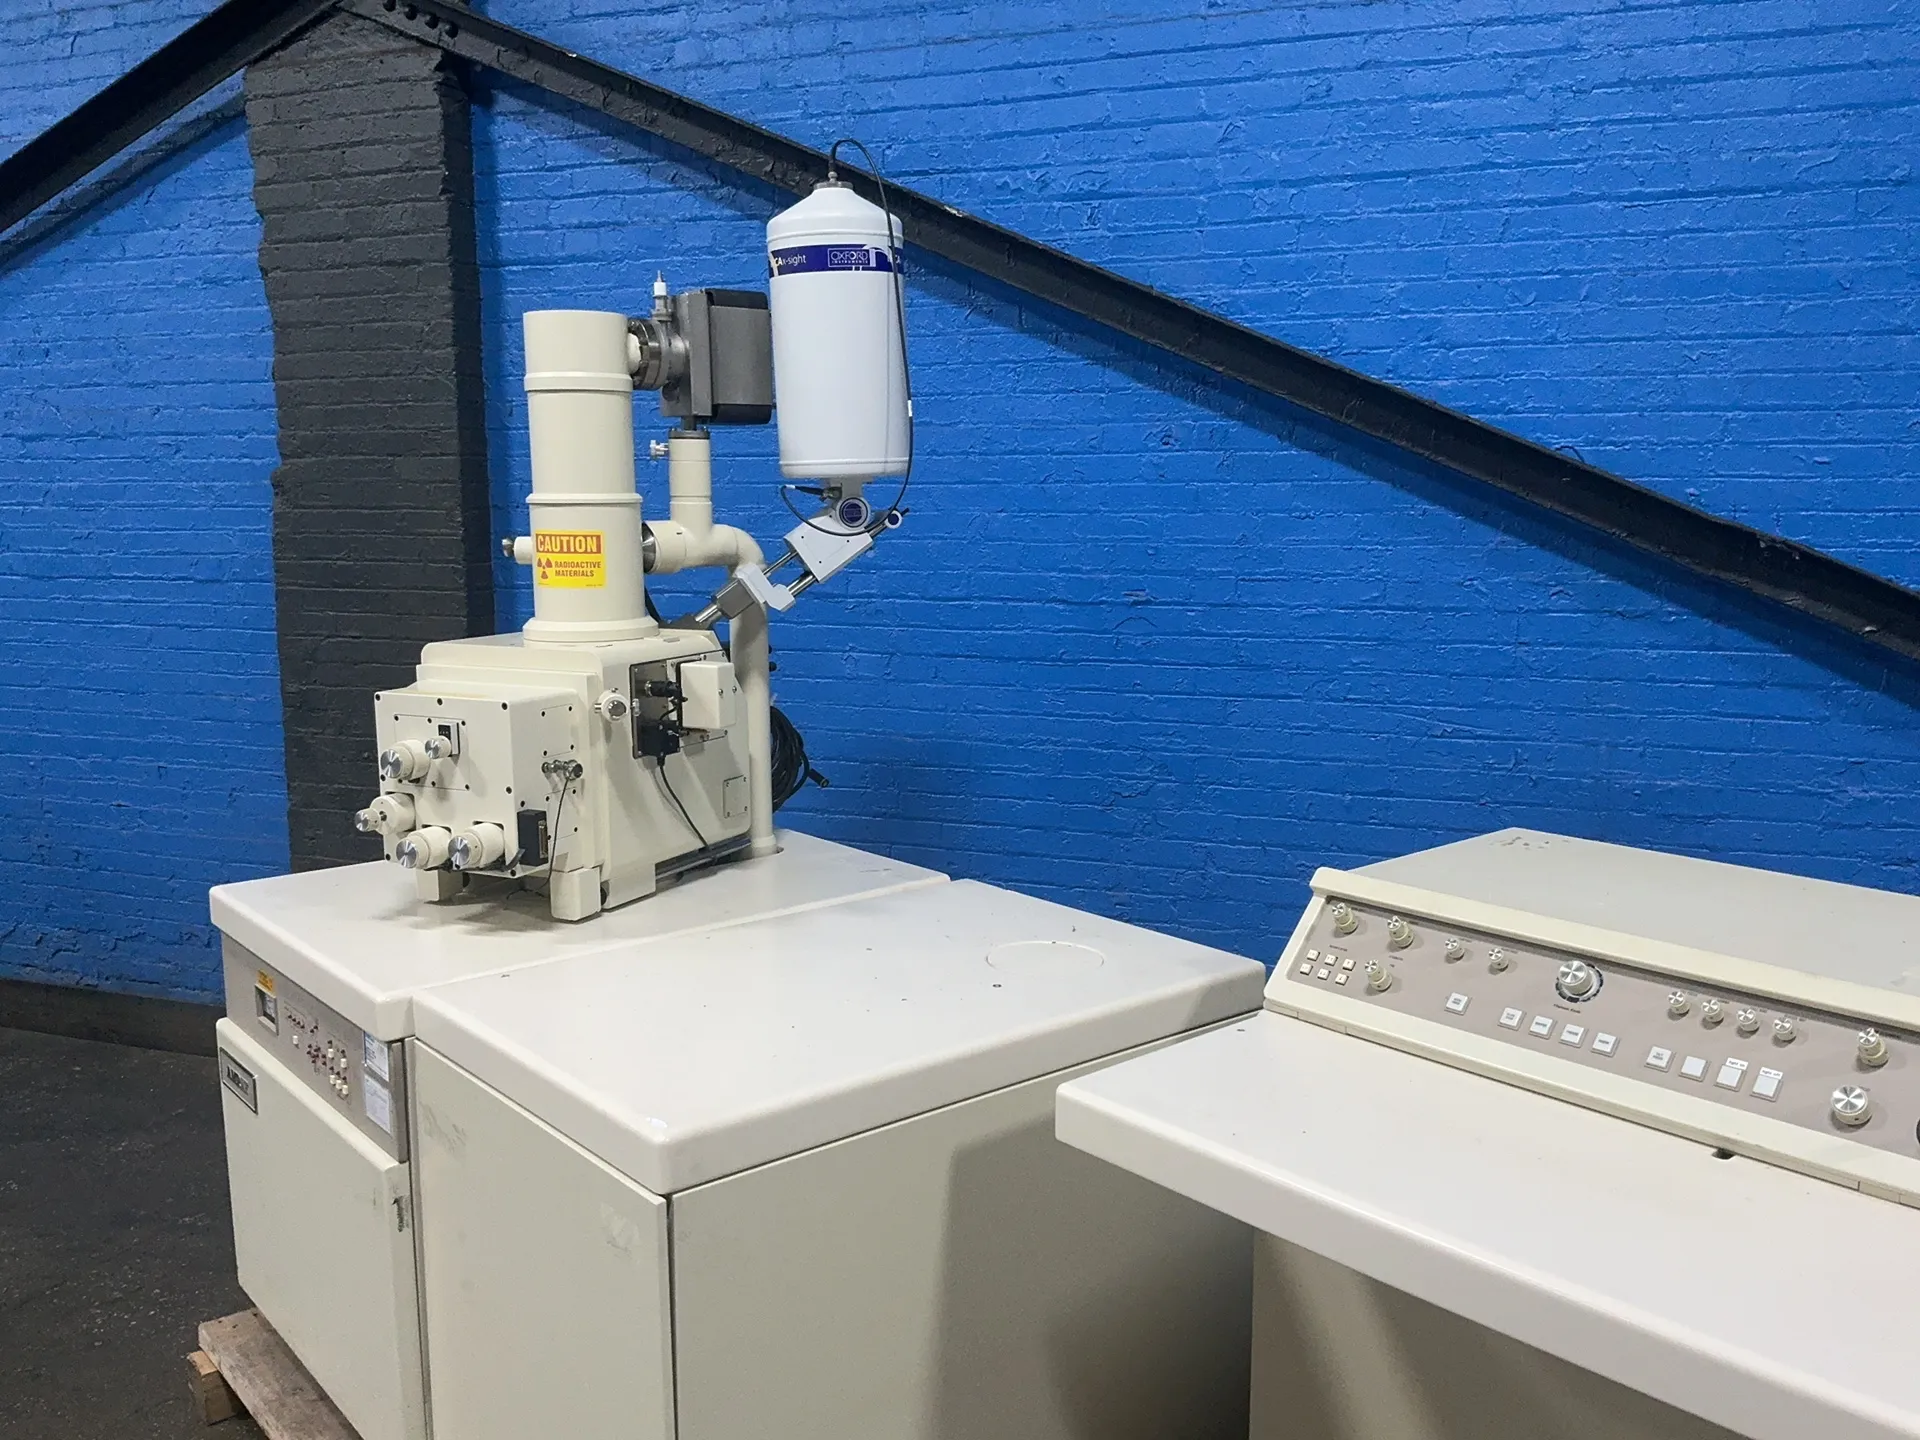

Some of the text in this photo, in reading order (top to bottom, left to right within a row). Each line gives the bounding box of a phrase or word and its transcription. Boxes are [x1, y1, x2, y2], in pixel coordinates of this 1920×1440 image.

[830, 251, 868, 261] OXFORD
[537, 535, 597, 553] CAUTION
[554, 560, 601, 568] RADIOACTIVE
[554, 569, 595, 577] MATERIALS
